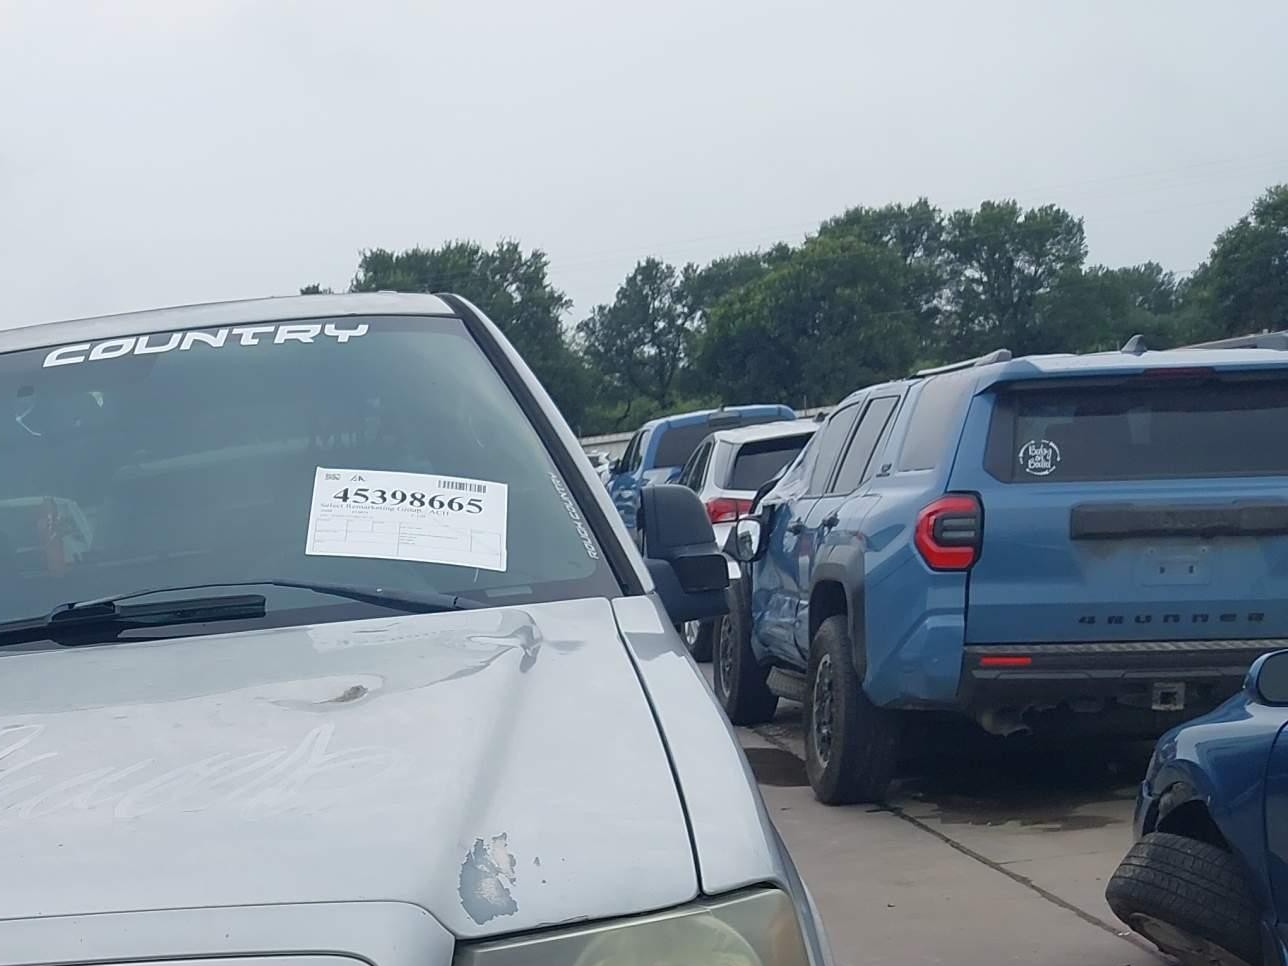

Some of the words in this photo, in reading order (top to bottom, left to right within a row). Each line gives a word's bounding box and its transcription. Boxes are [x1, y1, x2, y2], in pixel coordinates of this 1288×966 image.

[42, 323, 369, 368] COUNTRY
[1028, 444, 1053, 460] Baby
[332, 487, 484, 514] 45398665
[547, 471, 580, 521] COUNTRY
[573, 520, 599, 559] ROUGH
[1079, 613, 1264, 625] 4RUNNER
